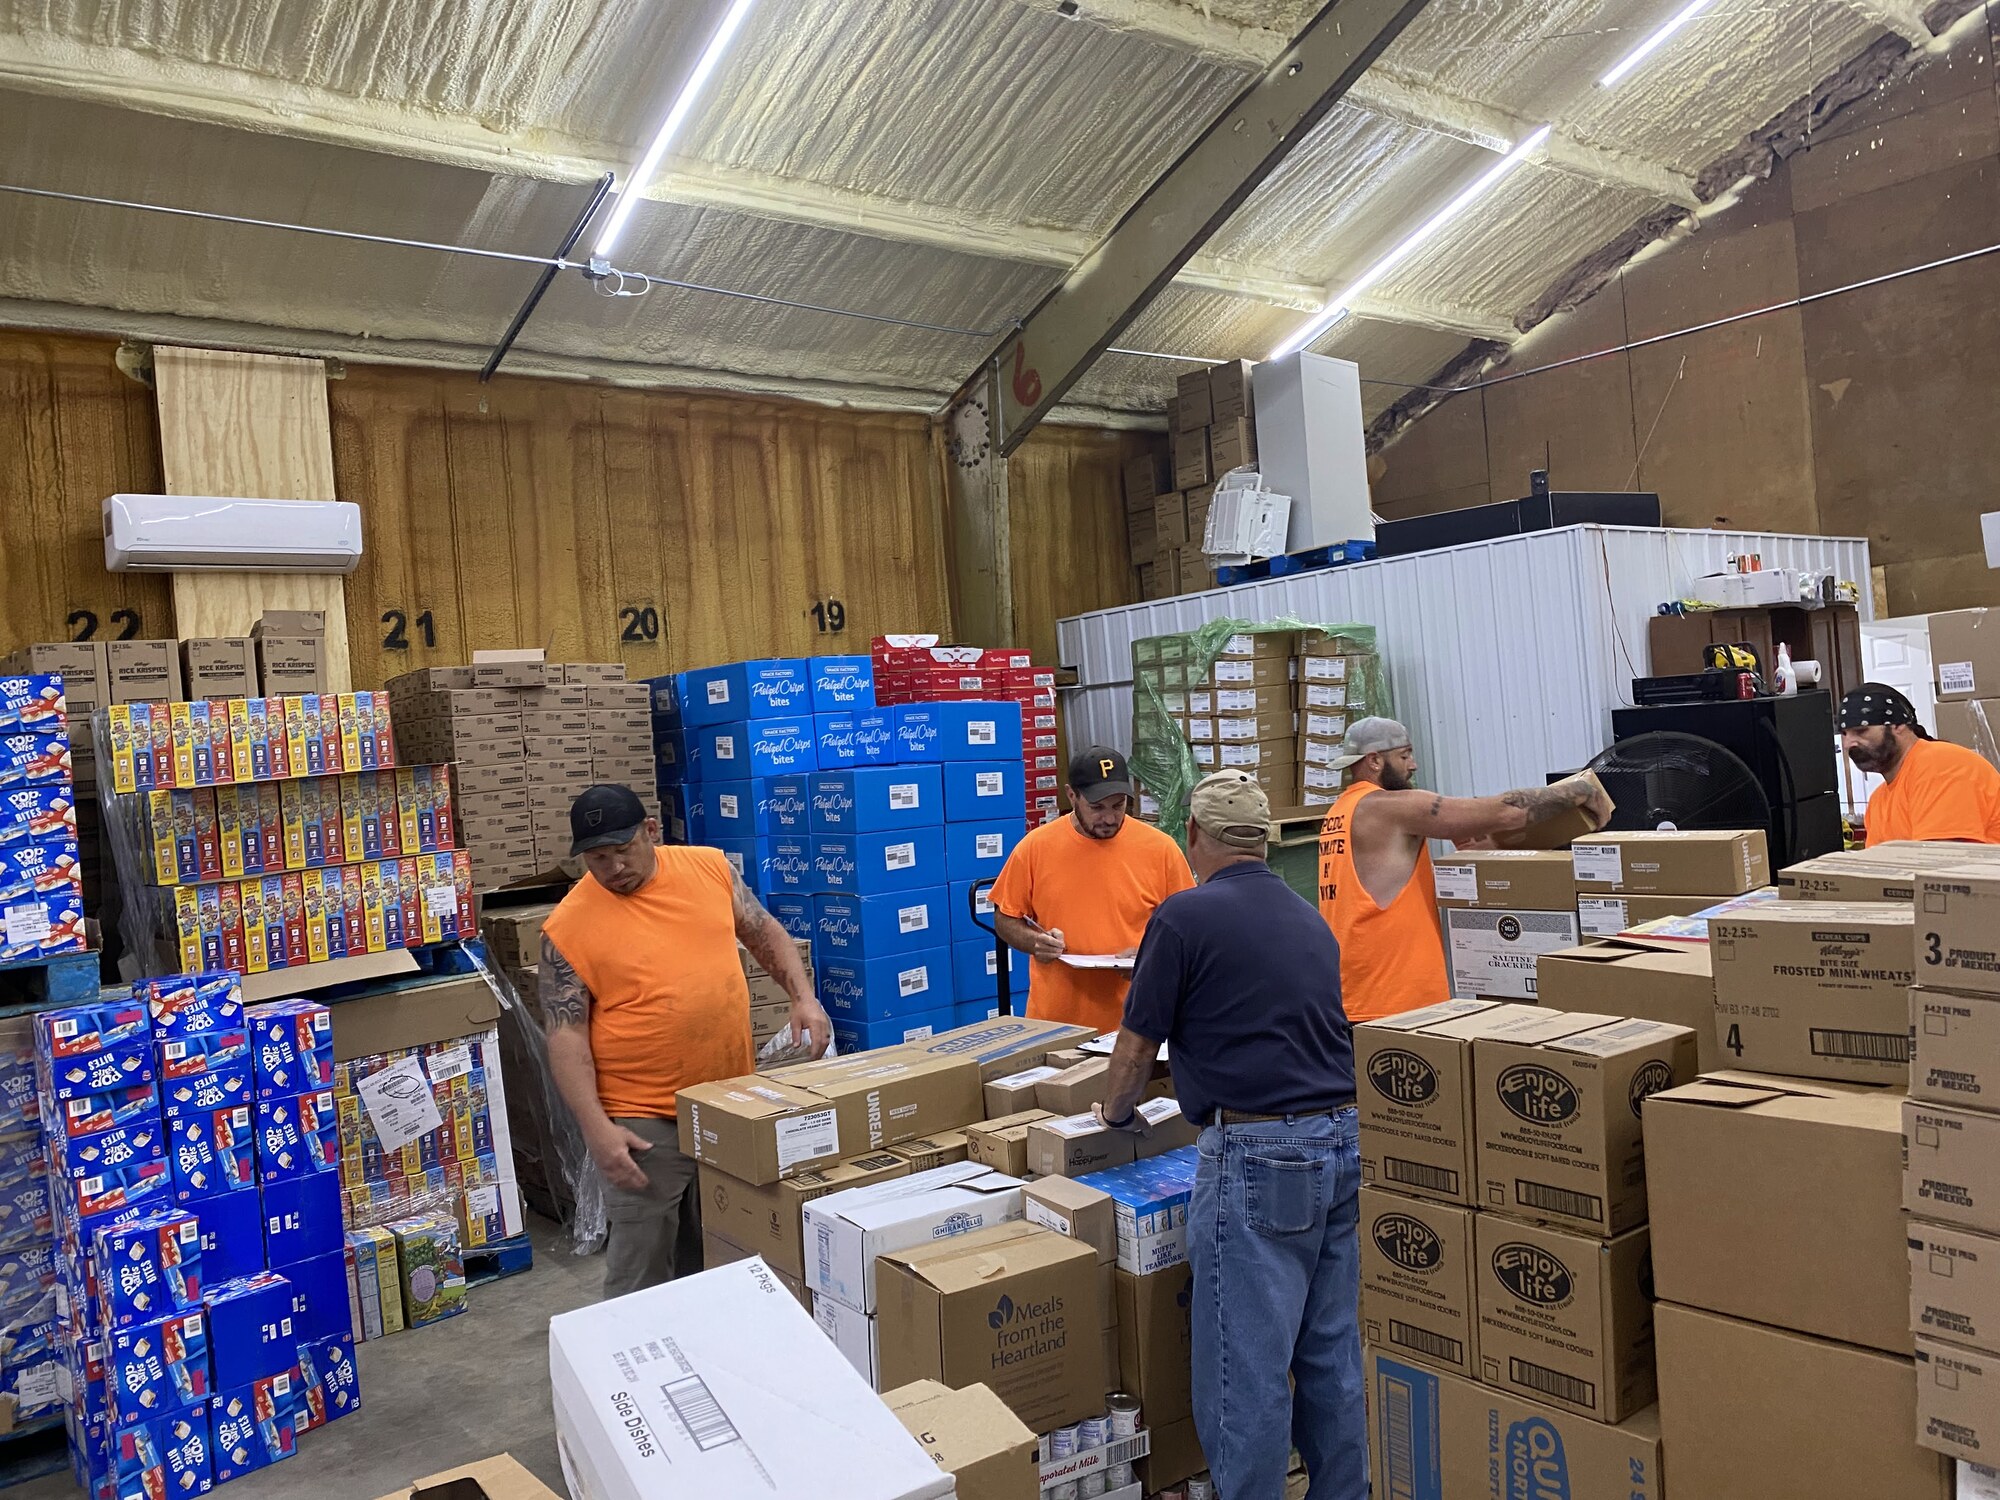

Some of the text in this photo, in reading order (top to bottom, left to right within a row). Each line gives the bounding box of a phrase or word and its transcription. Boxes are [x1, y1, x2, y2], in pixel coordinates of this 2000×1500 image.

[1013, 341, 1041, 406] 6
[67, 609, 140, 642] 22
[619, 607, 660, 641] 20
[811, 600, 845, 632] 19
[381, 610, 436, 649] 21
[50, 676, 61, 684] 20
[752, 679, 805, 700] Pretzel Crisps
[816, 675, 870, 696] Pretzel Crisps
[6, 695, 33, 710] BITES
[770, 697, 790, 707] bites
[834, 692, 855, 702] bites
[754, 737, 811, 759] Pretzel Crisps
[910, 742, 925, 751] bites
[773, 754, 795, 765] bites
[1099, 759, 1114, 778] P
[15, 807, 43, 823] BITES
[825, 812, 841, 822] bites
[20, 864, 48, 880] BITES
[1741, 840, 1753, 889] UNREAL
[1800, 879, 1828, 891] 12-2.5
[1717, 927, 1747, 938] 12-2.5
[1815, 933, 1866, 943] CEREAL CUPS
[1492, 955, 1533, 963] SALTINE
[1925, 932, 1943, 966] 3
[1949, 948, 1996, 962] PRODUCT
[1488, 961, 1537, 969] CRACKERS
[1773, 965, 1912, 981] FROSTED MINI-WHEATS
[1820, 959, 1859, 968] BITE SIZE
[1945, 957, 2000, 972] OF MEXICO
[256, 1021, 264, 1031] 20
[1726, 1023, 1744, 1057] 4
[88, 1053, 115, 1071] BITES
[280, 1041, 294, 1063] BITES
[1370, 1052, 1429, 1082] Enjoy
[1930, 1068, 1976, 1084] PRODUCT
[59, 1090, 72, 1099] 20
[1390, 1076, 1424, 1099] life
[1501, 1072, 1570, 1101] Enjoy
[1926, 1077, 1981, 1094] OF MEXICO
[1525, 1093, 1562, 1118] life
[866, 1090, 882, 1149] UNREAL
[691, 1104, 702, 1160] UNREAL
[1534, 1151, 1549, 1161] SOFT
[1550, 1154, 1570, 1166] BAKED
[1572, 1159, 1600, 1172] COOKIES
[1919, 1188, 1973, 1207] OF MEXICO
[1922, 1179, 1968, 1197] PRODUCT
[1376, 1221, 1434, 1248] Enjoy
[114, 1239, 123, 1251] 20
[1151, 1242, 1177, 1255] MUFFIN
[1396, 1240, 1428, 1265] life
[1156, 1251, 1172, 1260] LIKE
[140, 1260, 158, 1285] BITES
[1497, 1250, 1563, 1282] Enjoy
[747, 1263, 776, 1294] 12 Pkgs
[1519, 1271, 1556, 1299] life
[1015, 1296, 1064, 1323] Meals
[1925, 1305, 1971, 1325] PRODUCT
[997, 1316, 1065, 1349] from the
[1529, 1331, 1544, 1342] SOFT
[1936, 1318, 1976, 1336] MEXICO
[991, 1331, 1066, 1370] Heartland
[324, 1371, 339, 1394] BITES
[213, 1397, 221, 1409] 20
[351, 1397, 360, 1408] 20
[238, 1415, 254, 1439] BITES
[610, 1391, 655, 1458] Side Dishes
[1488, 1409, 1499, 1496] ULTRA SOFT
[1040, 1455, 1100, 1485] aporated Milk
[1629, 1456, 1645, 1485] 24
